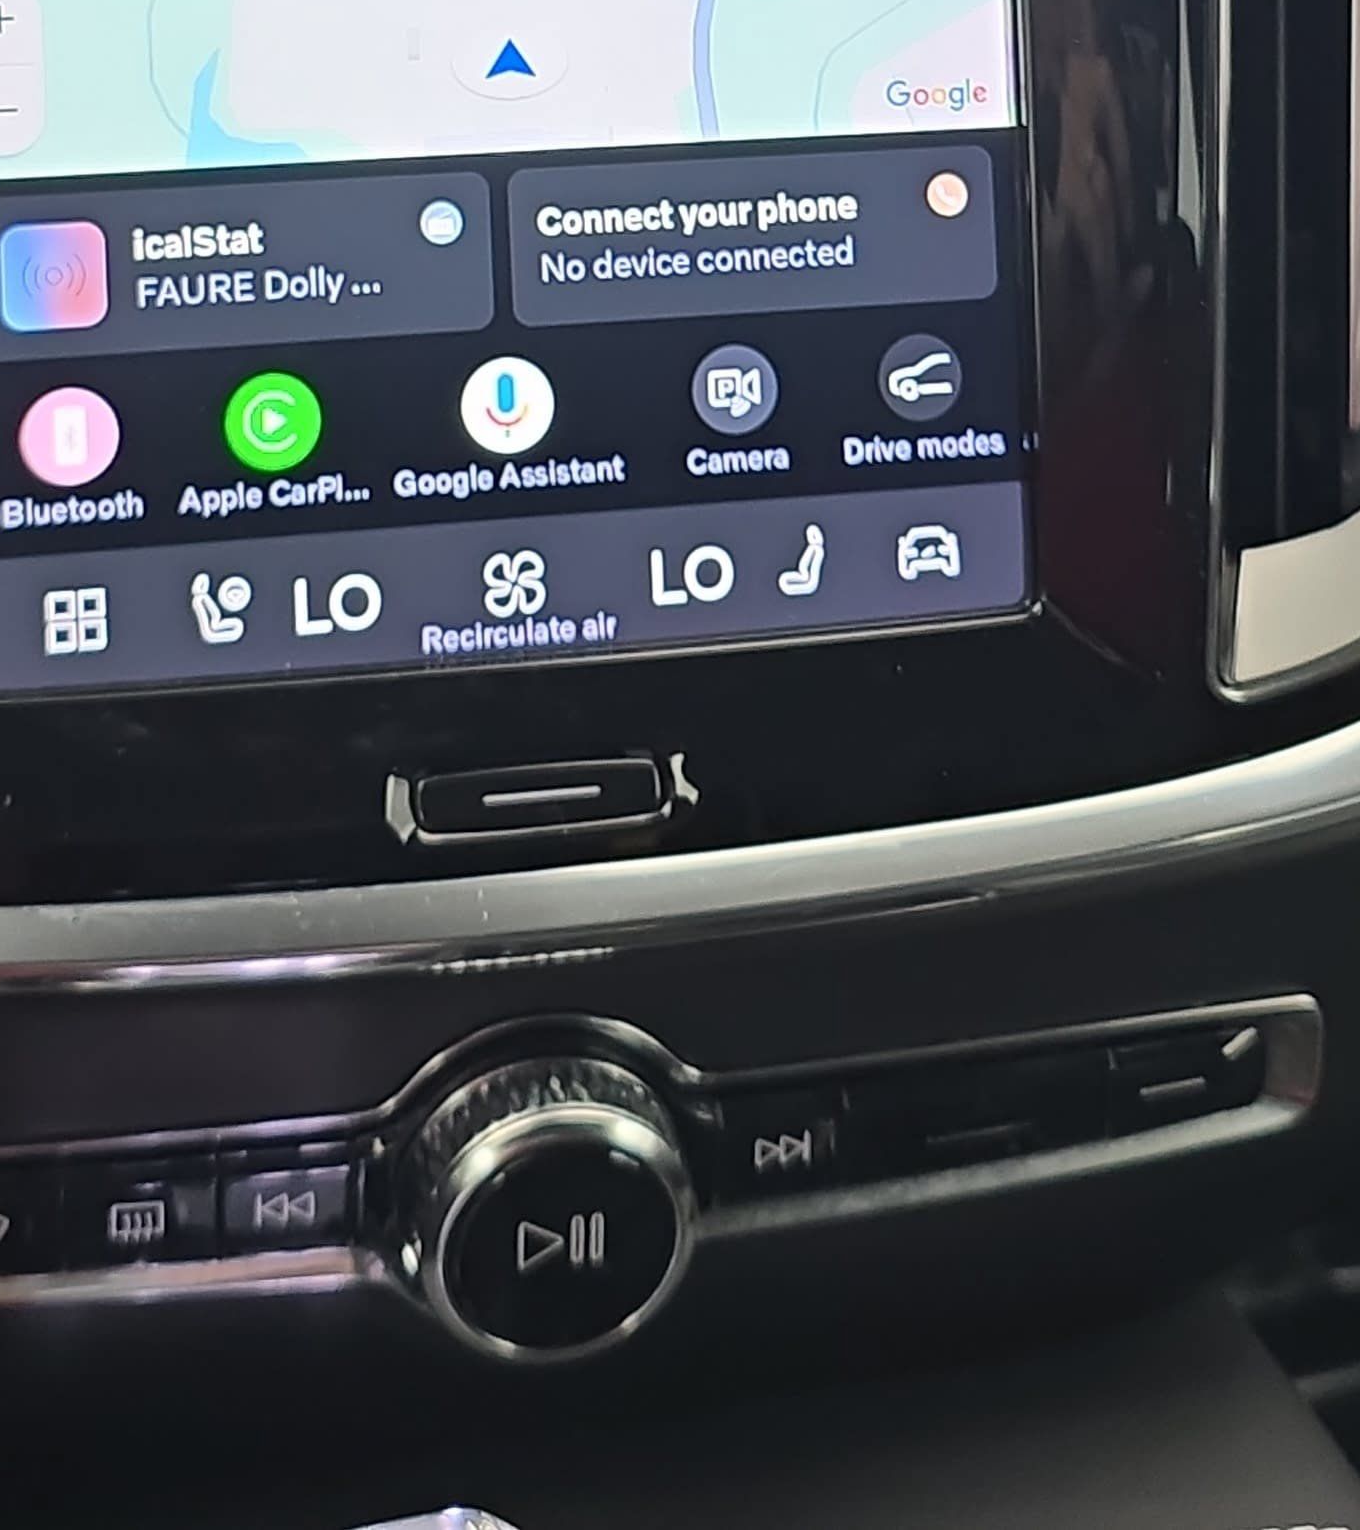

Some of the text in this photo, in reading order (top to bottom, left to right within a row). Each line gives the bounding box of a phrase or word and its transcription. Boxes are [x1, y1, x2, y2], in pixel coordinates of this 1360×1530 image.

[885, 78, 988, 112] Google
[536, 191, 858, 238] Connect your phone
[540, 235, 856, 283] No device connected
[136, 269, 256, 309] FAURE
[264, 265, 344, 304] Dolly
[686, 446, 791, 479] Camera
[843, 429, 1006, 466] Drive modes
[177, 482, 264, 518] Apple
[392, 453, 626, 502] Google Assistant
[649, 545, 735, 607] LO
[292, 573, 383, 637] LO
[421, 611, 618, 656] Recirculate air
